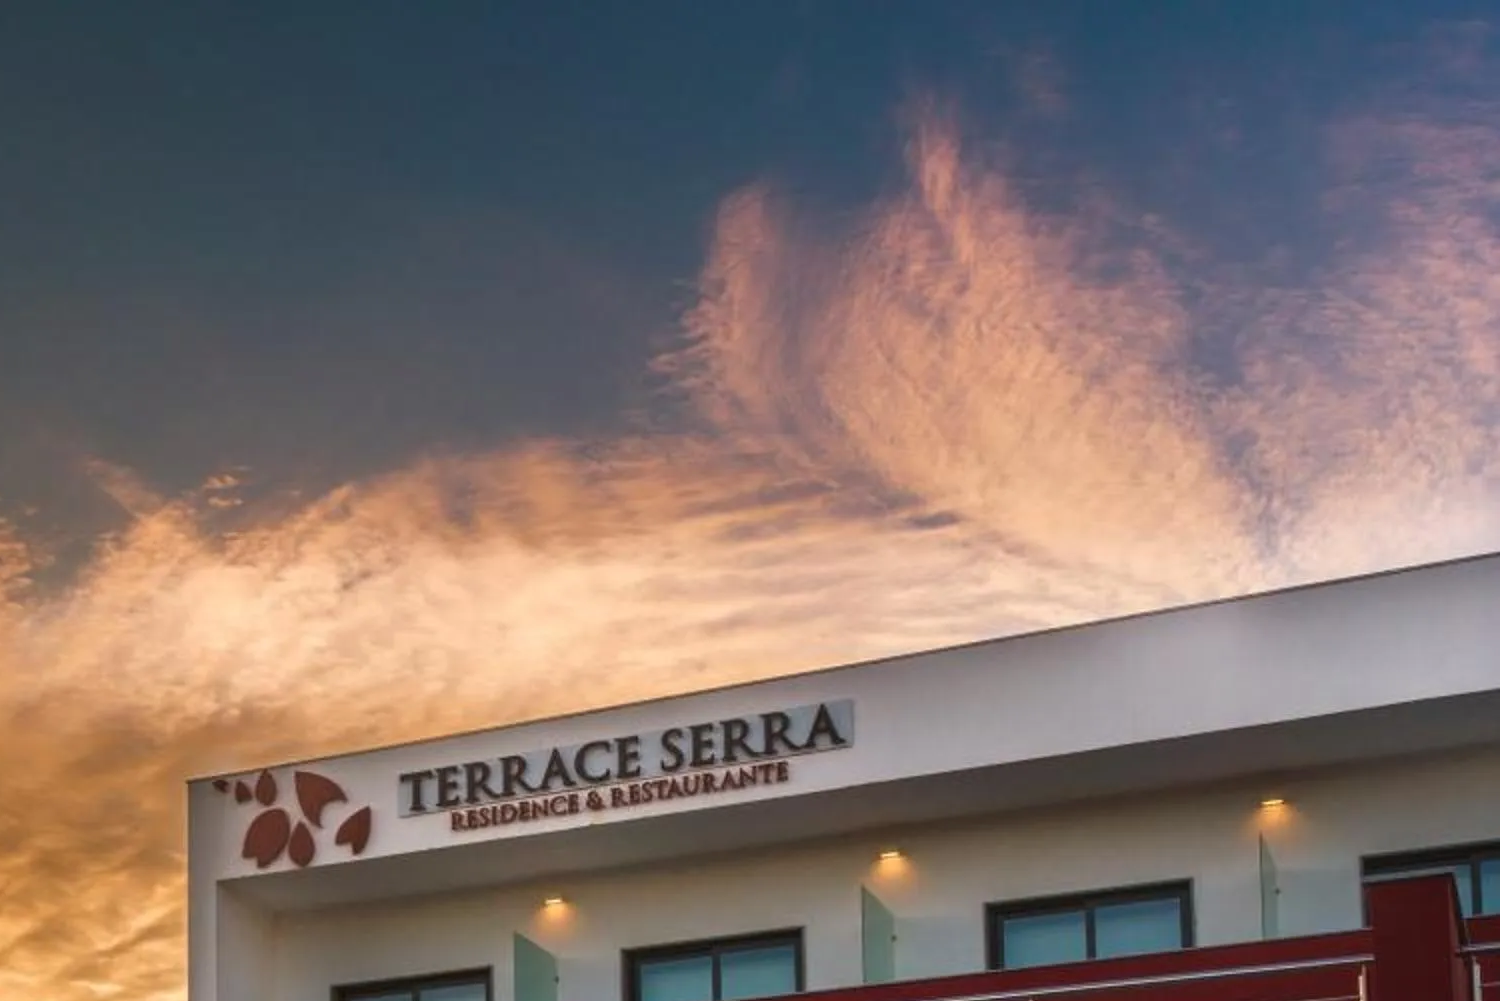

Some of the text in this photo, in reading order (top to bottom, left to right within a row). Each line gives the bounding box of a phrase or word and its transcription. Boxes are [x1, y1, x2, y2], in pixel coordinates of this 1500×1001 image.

[400, 704, 846, 811] TERRACE SERRA
[451, 761, 789, 831] RESIDENCE & RESTAURANTE
